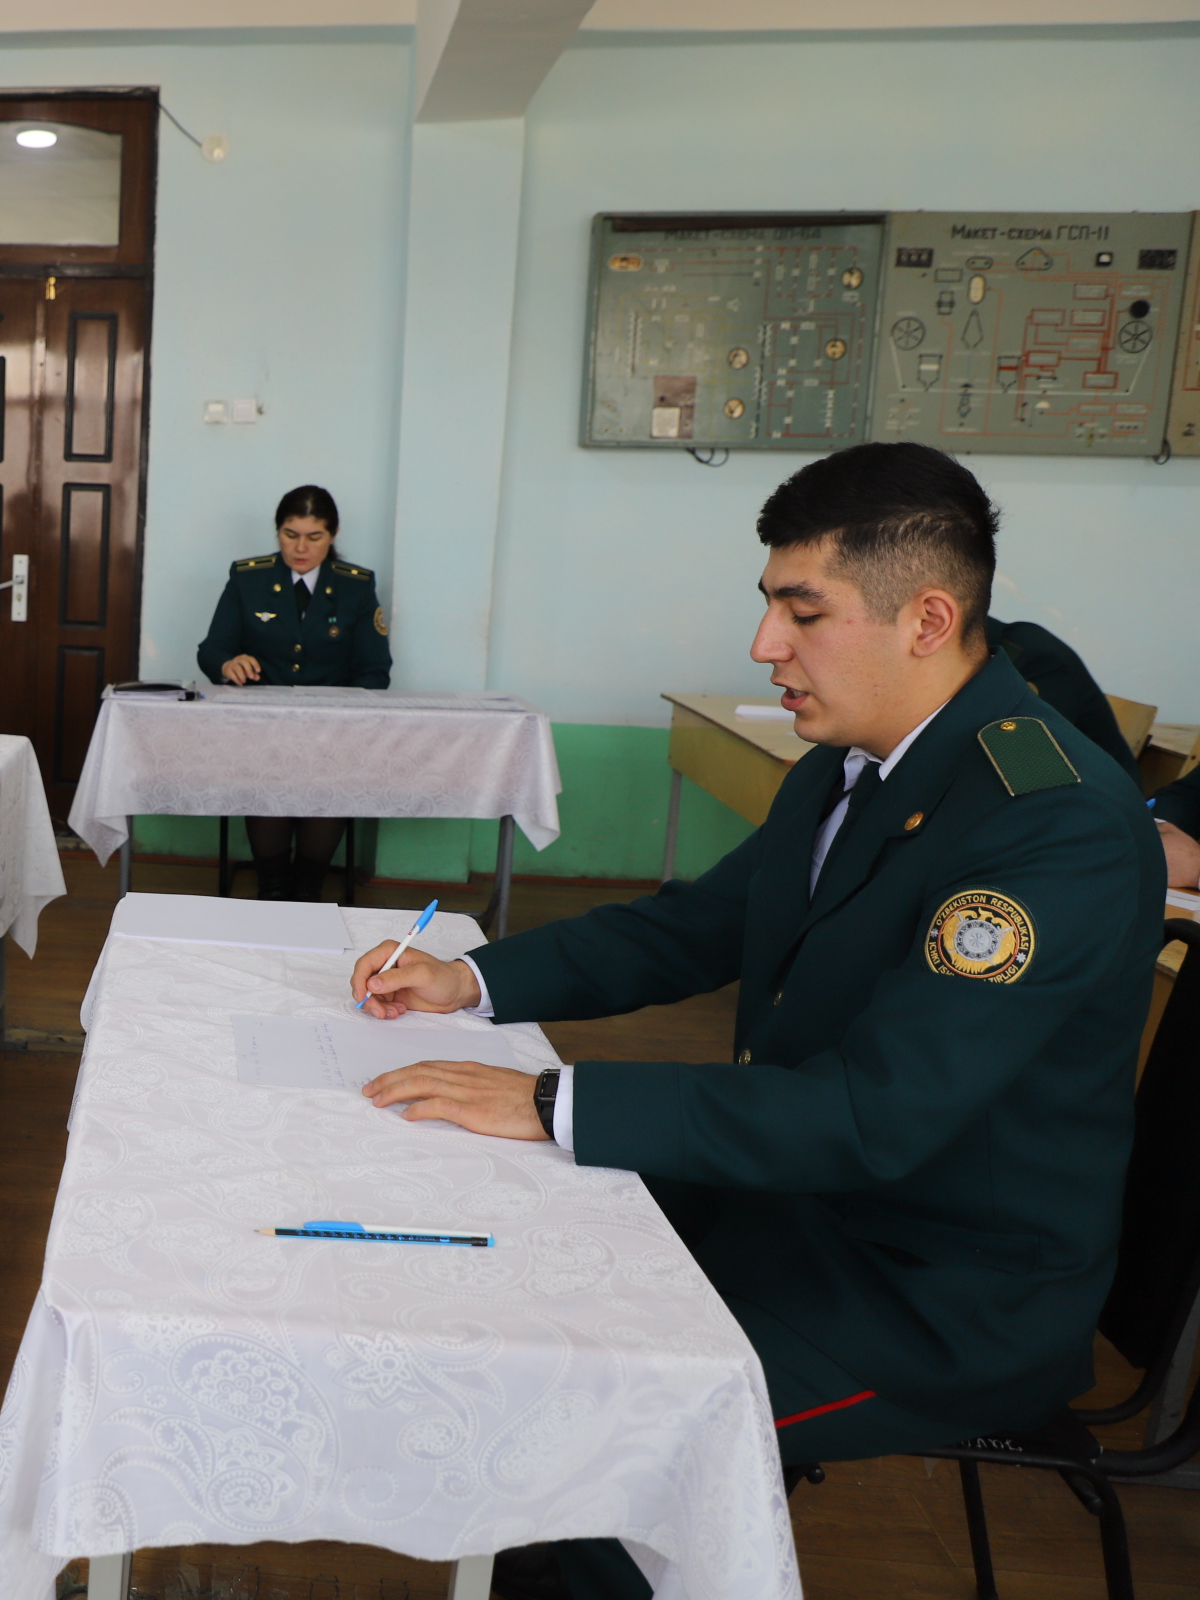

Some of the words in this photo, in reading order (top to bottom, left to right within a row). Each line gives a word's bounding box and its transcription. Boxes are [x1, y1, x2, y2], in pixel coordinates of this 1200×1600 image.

[936, 895, 986, 926] O'ZBEKISTON
[990, 897, 1029, 950] RESPUBLIKASI
[928, 941, 941, 965] ICHKI
